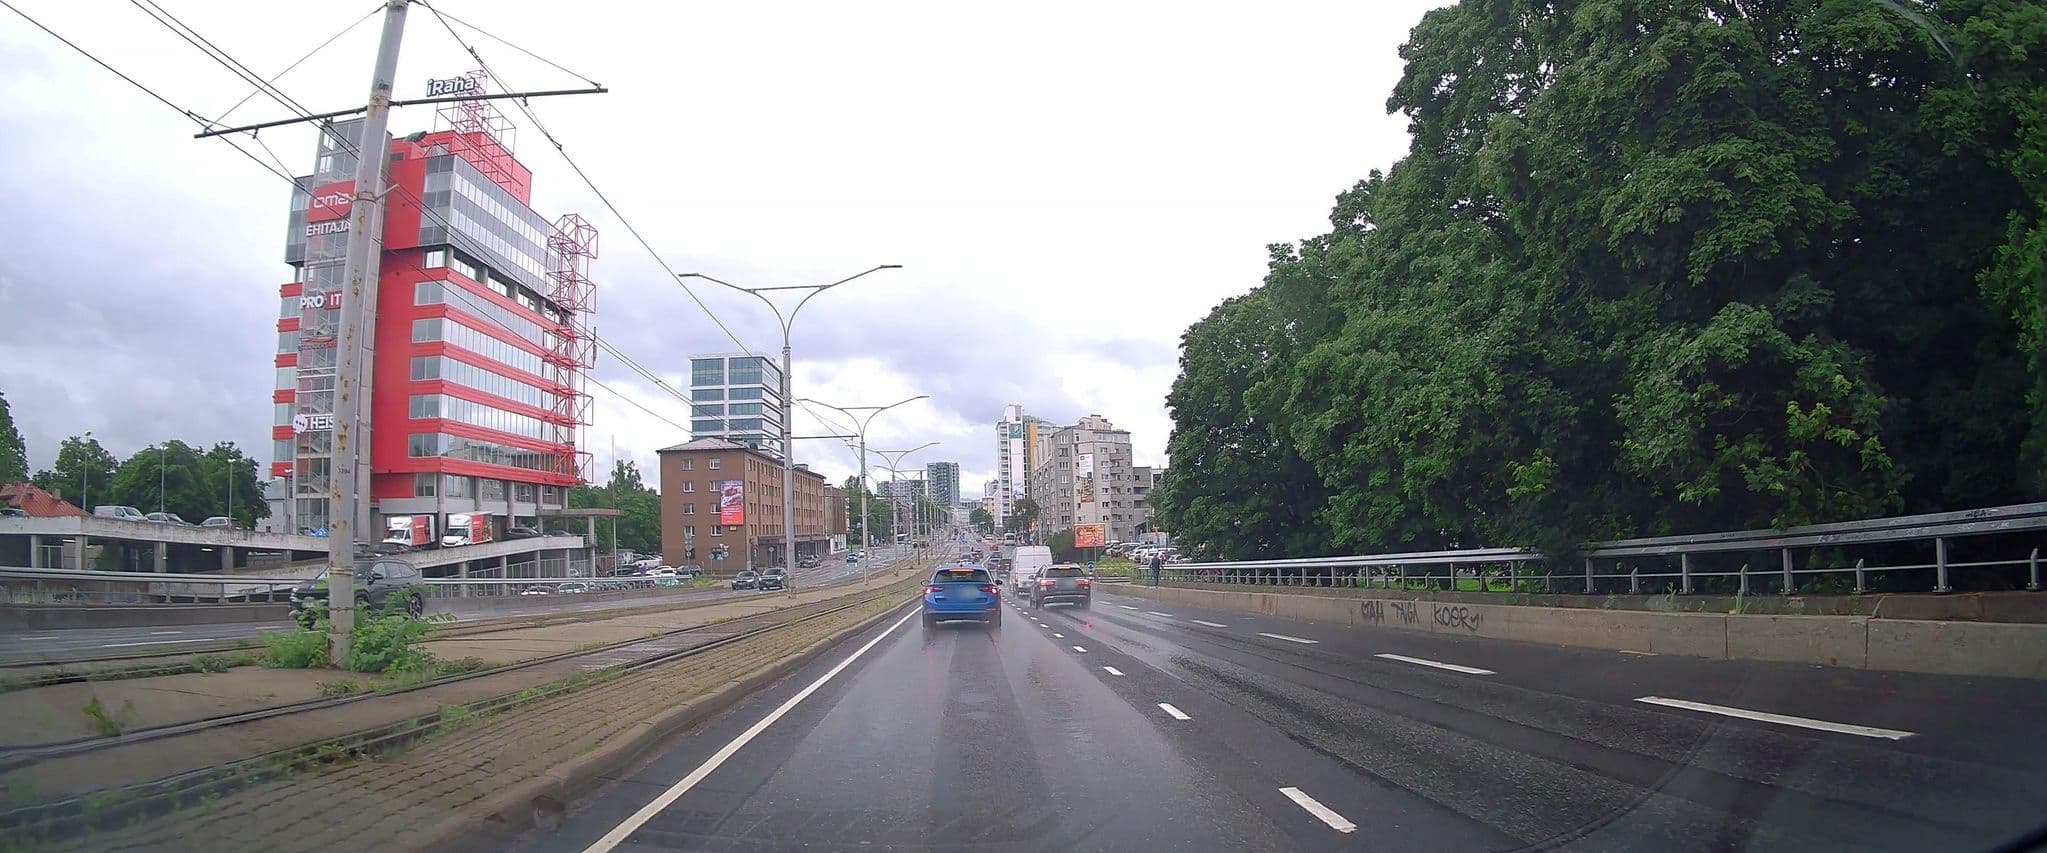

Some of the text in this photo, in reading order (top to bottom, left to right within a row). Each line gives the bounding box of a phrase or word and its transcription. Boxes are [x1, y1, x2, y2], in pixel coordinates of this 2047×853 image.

[427, 77, 476, 97] iRaha
[306, 221, 351, 236] EHITAJA
[300, 294, 342, 309] PRO IT
